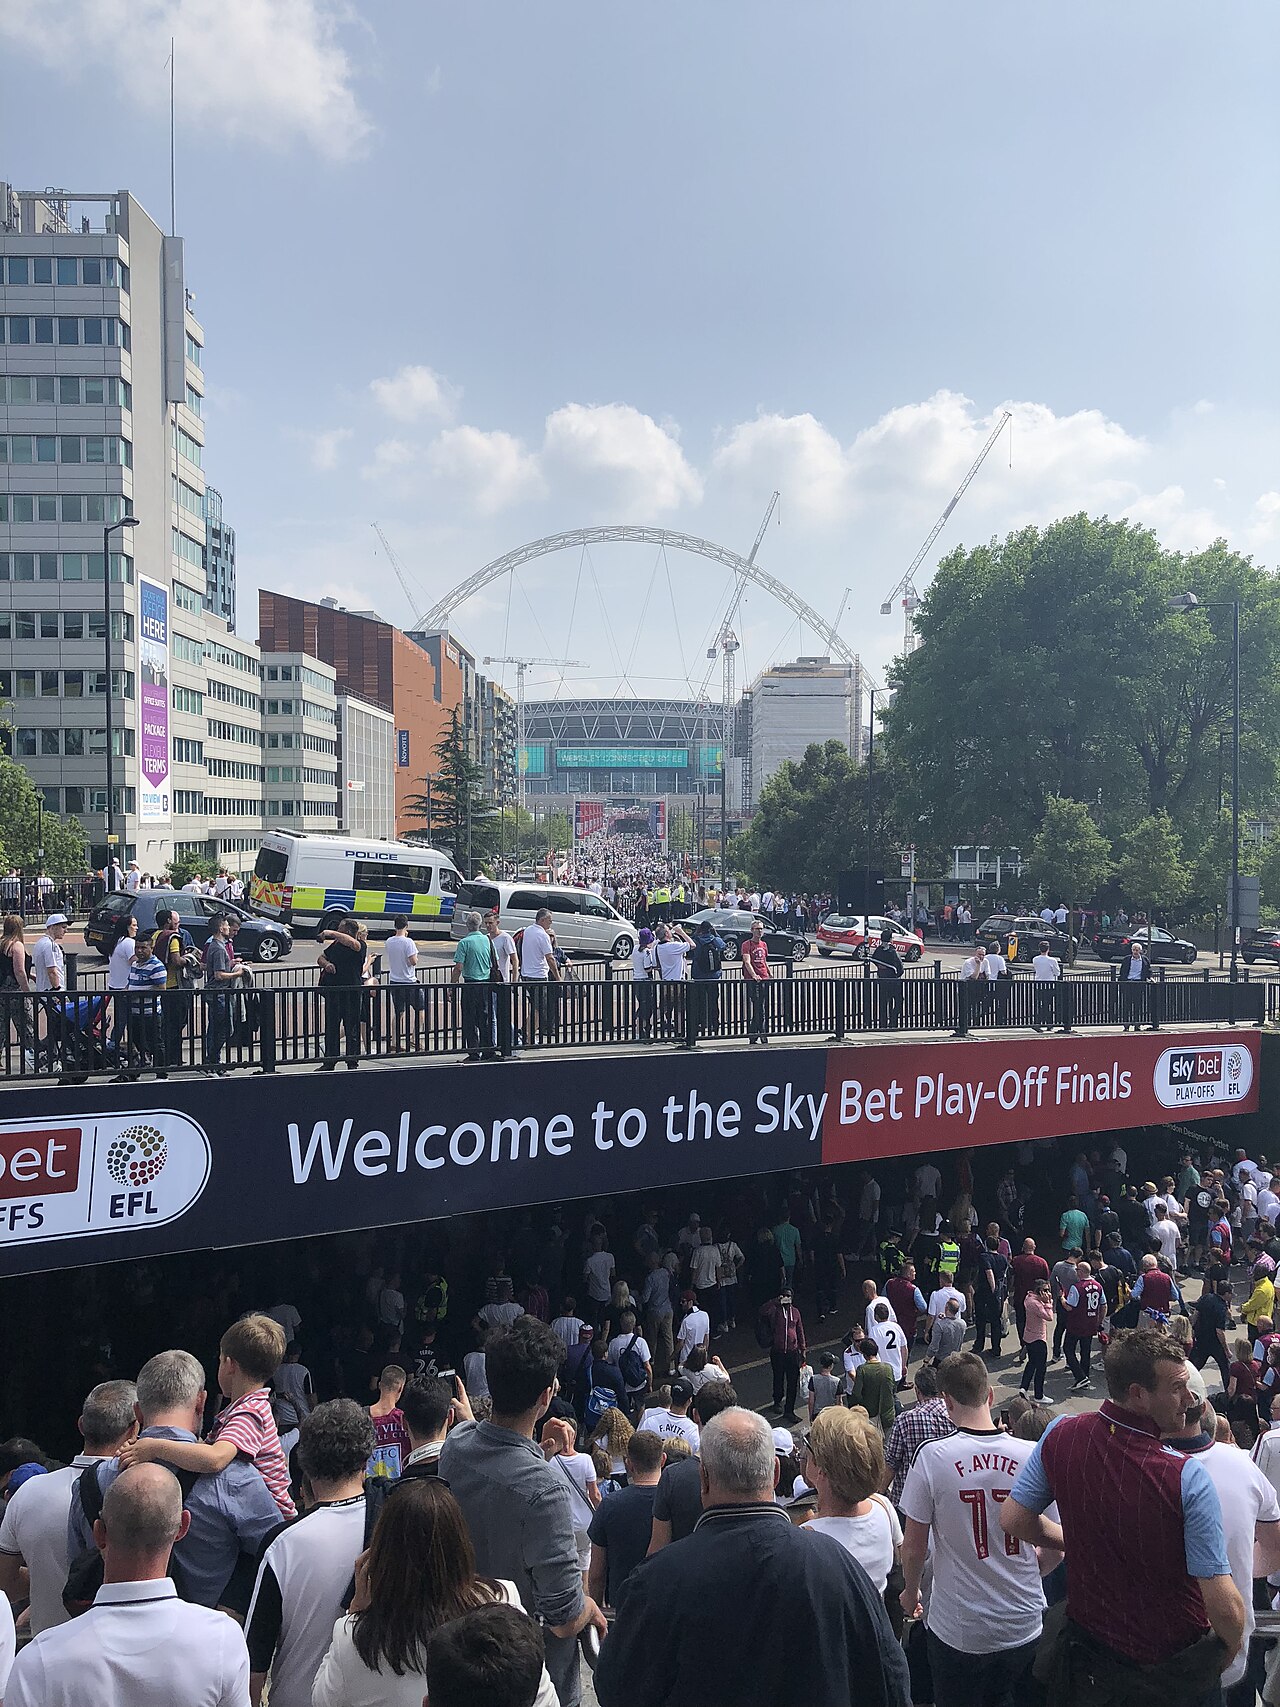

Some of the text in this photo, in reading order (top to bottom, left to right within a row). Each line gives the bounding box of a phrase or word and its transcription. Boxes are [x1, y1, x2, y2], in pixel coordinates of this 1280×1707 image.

[143, 599, 165, 622] OFFICE
[143, 615, 165, 641] HERE
[144, 723, 166, 737] PACKAGE
[144, 744, 166, 759] FLEXIBLE
[561, 754, 682, 763] WEMBLEY CONNECTED BY EE
[144, 758, 167, 774] TERMS
[345, 850, 398, 861] POLICE
[1172, 1055, 1220, 1082] sky bet
[1175, 1084, 1215, 1101] PLAY-OFFS
[1228, 1082, 1241, 1096] EFL
[287, 1061, 1132, 1184] Welcome to the Sky Bet Play-Off Finals
[1183, 1127, 1208, 1143] Designer
[0, 1138, 67, 1182] et
[109, 1190, 158, 1219] EFL
[1086, 1291, 1100, 1310] 18
[885, 1330, 897, 1350] 2
[414, 1358, 438, 1377] 26
[371, 1447, 397, 1460] VFC
[954, 1453, 1019, 1478] F.AYITE
